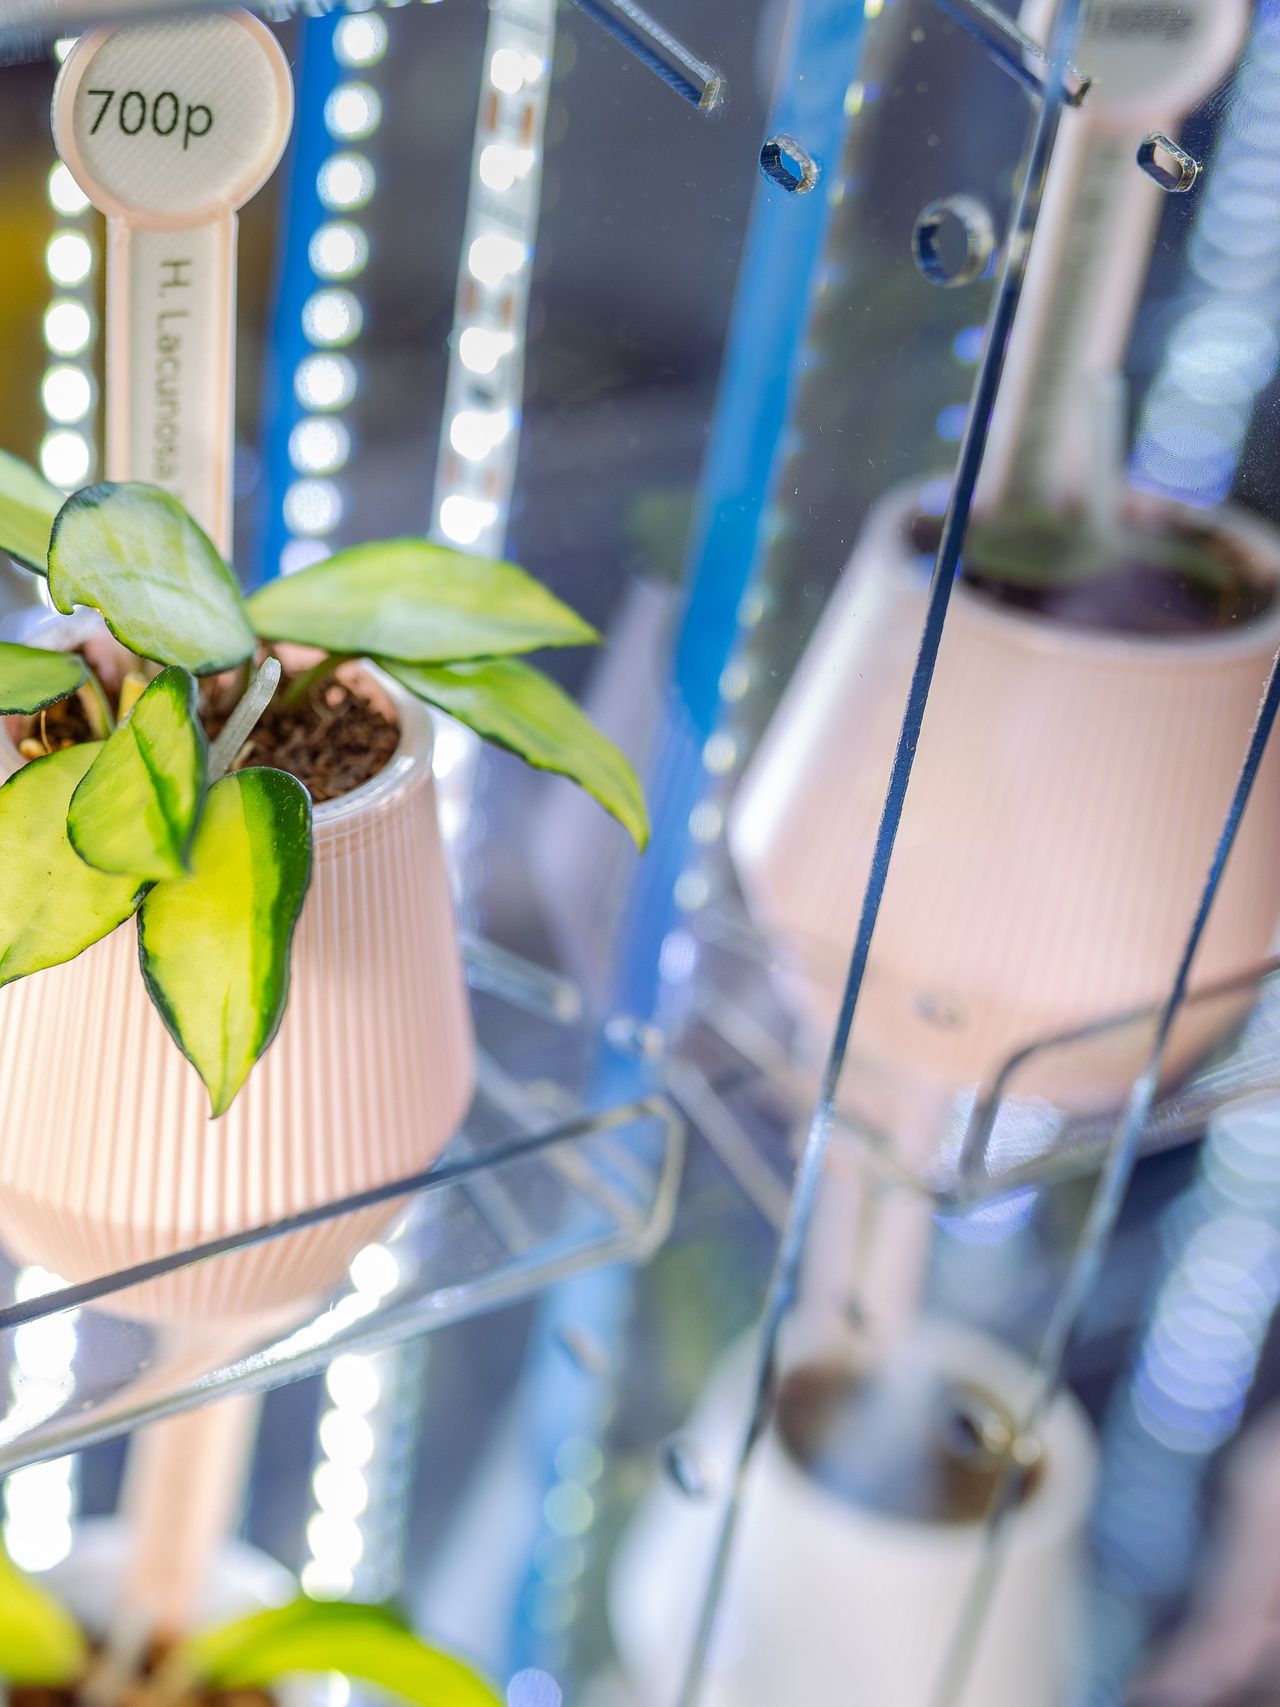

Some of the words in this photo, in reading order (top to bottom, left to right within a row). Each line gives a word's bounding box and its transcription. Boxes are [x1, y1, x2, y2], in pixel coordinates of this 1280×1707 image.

[87, 90, 214, 150] 700p
[157, 258, 191, 298] H.
[152, 310, 190, 480] Lacunosa
